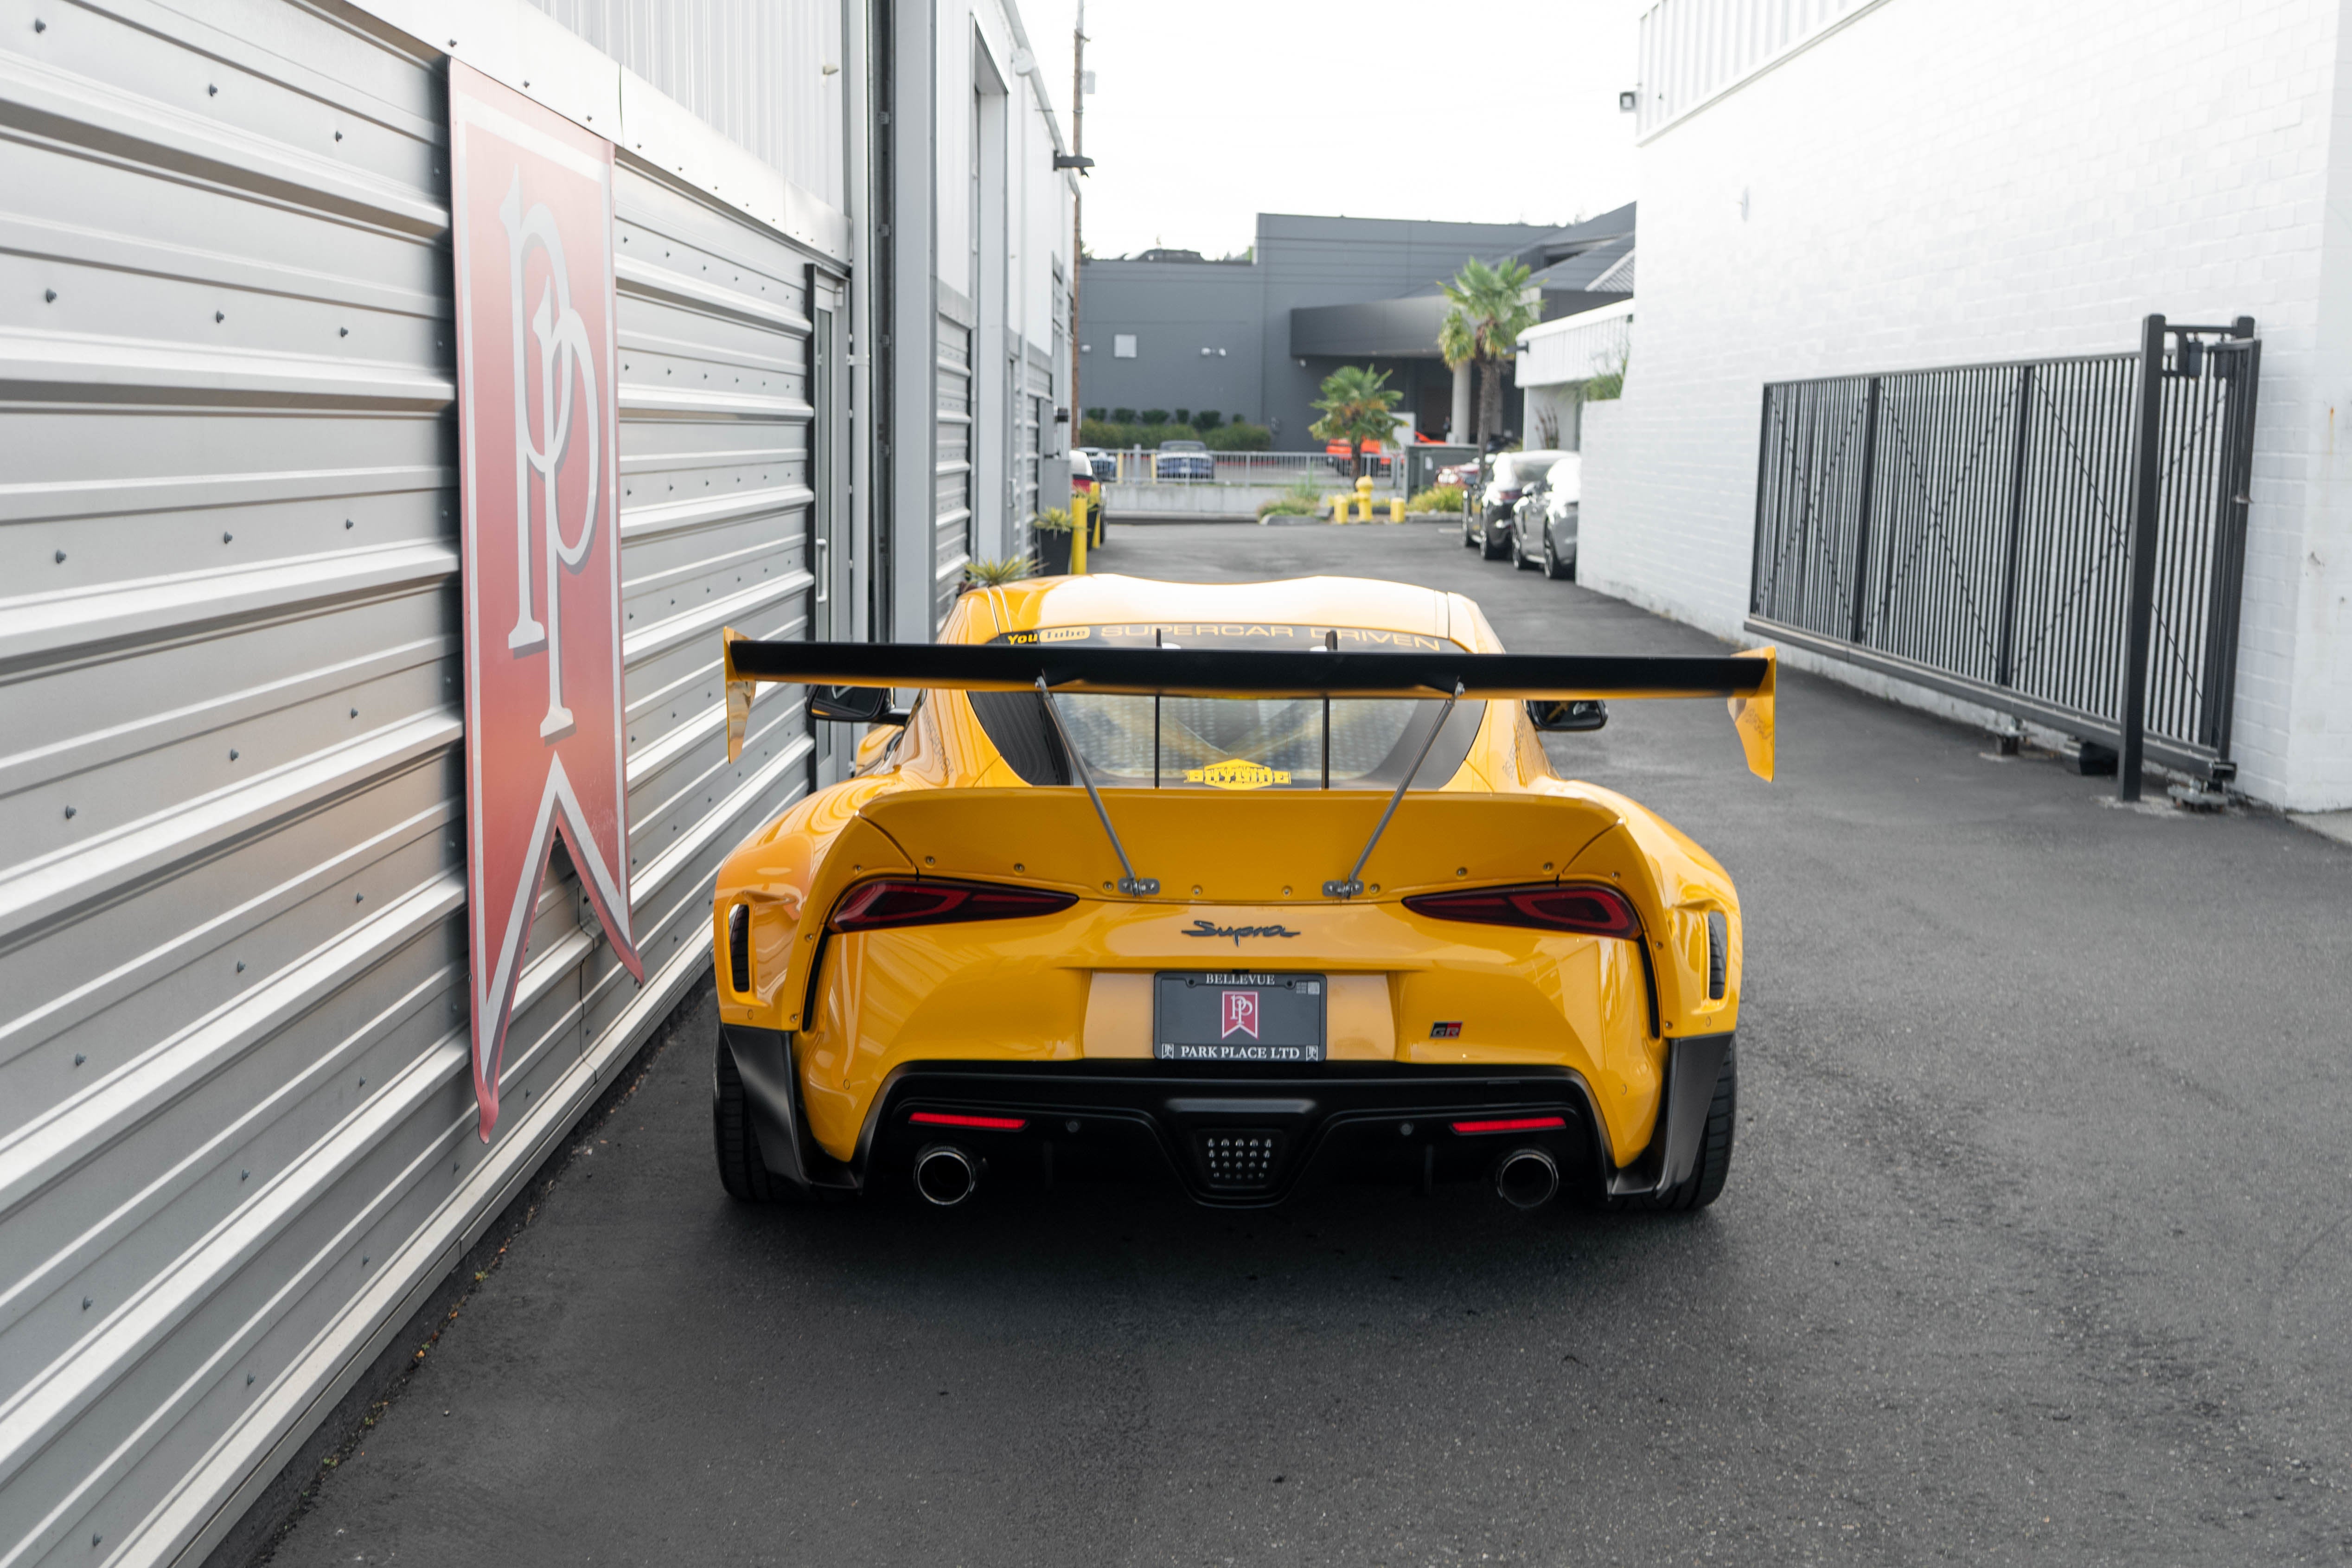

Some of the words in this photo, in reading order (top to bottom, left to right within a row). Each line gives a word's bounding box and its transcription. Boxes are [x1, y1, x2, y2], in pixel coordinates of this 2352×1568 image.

[1100, 625, 1294, 638] SUPERCAR
[1310, 627, 1440, 651] DRIVEN
[1181, 920, 1301, 947] Supra
[1206, 973, 1275, 986] BELLEVUE
[1431, 1026, 1460, 1038] GR
[1181, 1045, 1218, 1058] PARK
[1221, 1046, 1267, 1059] PLACE
[1270, 1046, 1300, 1059] LTD
